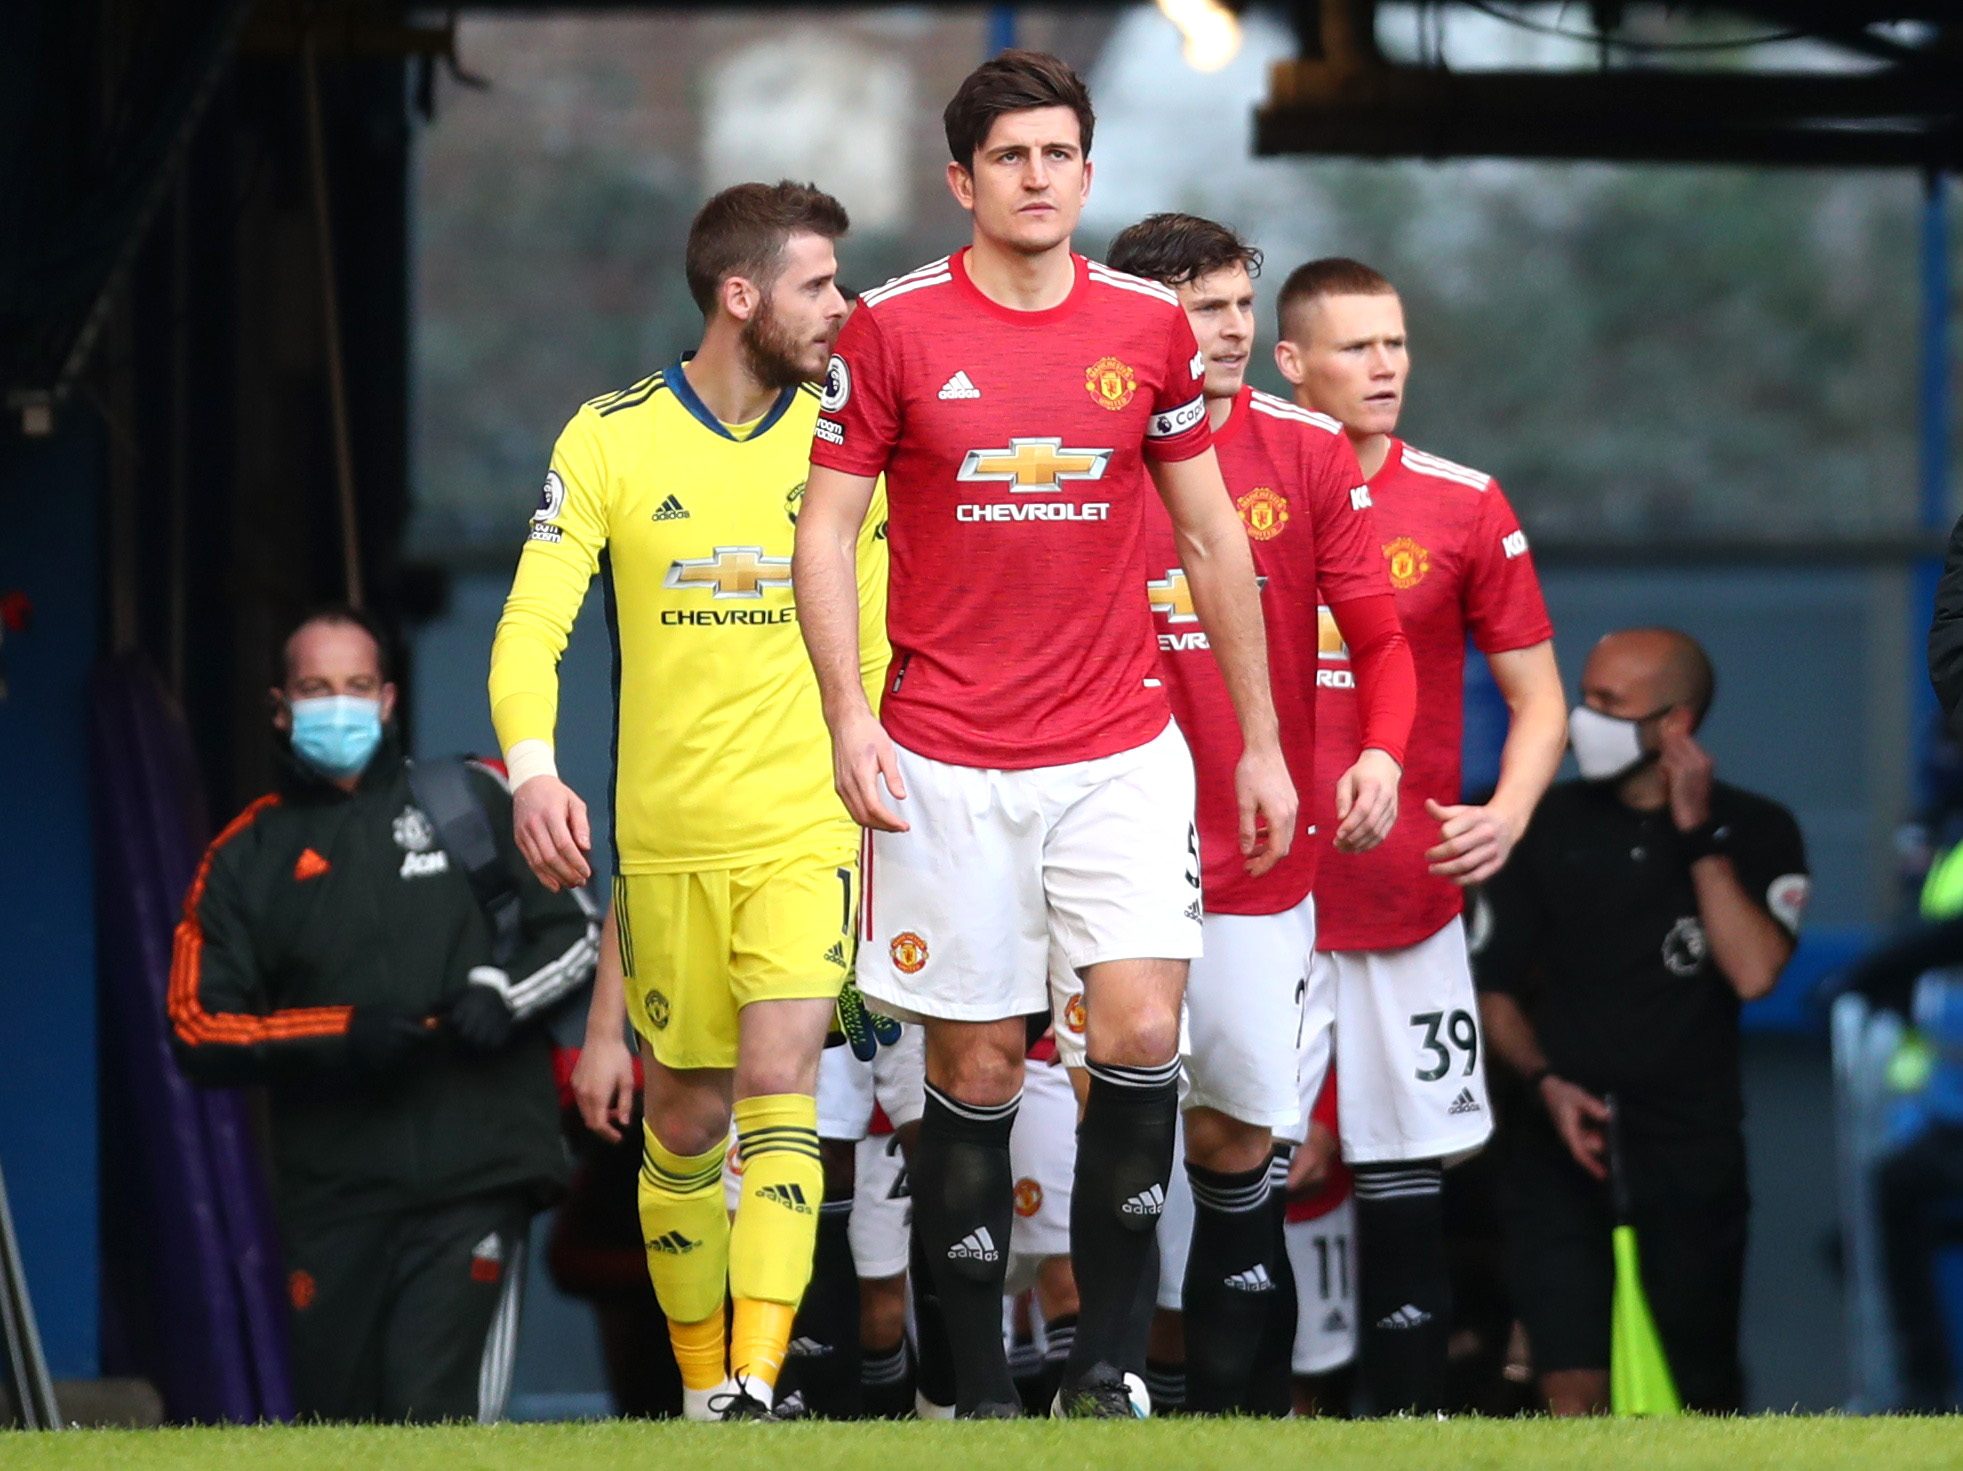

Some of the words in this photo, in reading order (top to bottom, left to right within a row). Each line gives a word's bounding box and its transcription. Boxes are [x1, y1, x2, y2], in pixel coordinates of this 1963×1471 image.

[938, 389, 981, 400] adidas
[817, 418, 842, 435] room
[651, 510, 690, 521] adidas
[956, 503, 1110, 522] CHEVROLET
[836, 867, 851, 936] 1
[1409, 1009, 1477, 1082] 39
[755, 1190, 812, 1215] adidas
[947, 1249, 999, 1262] adidas
[1312, 1236, 1348, 1299] 11
